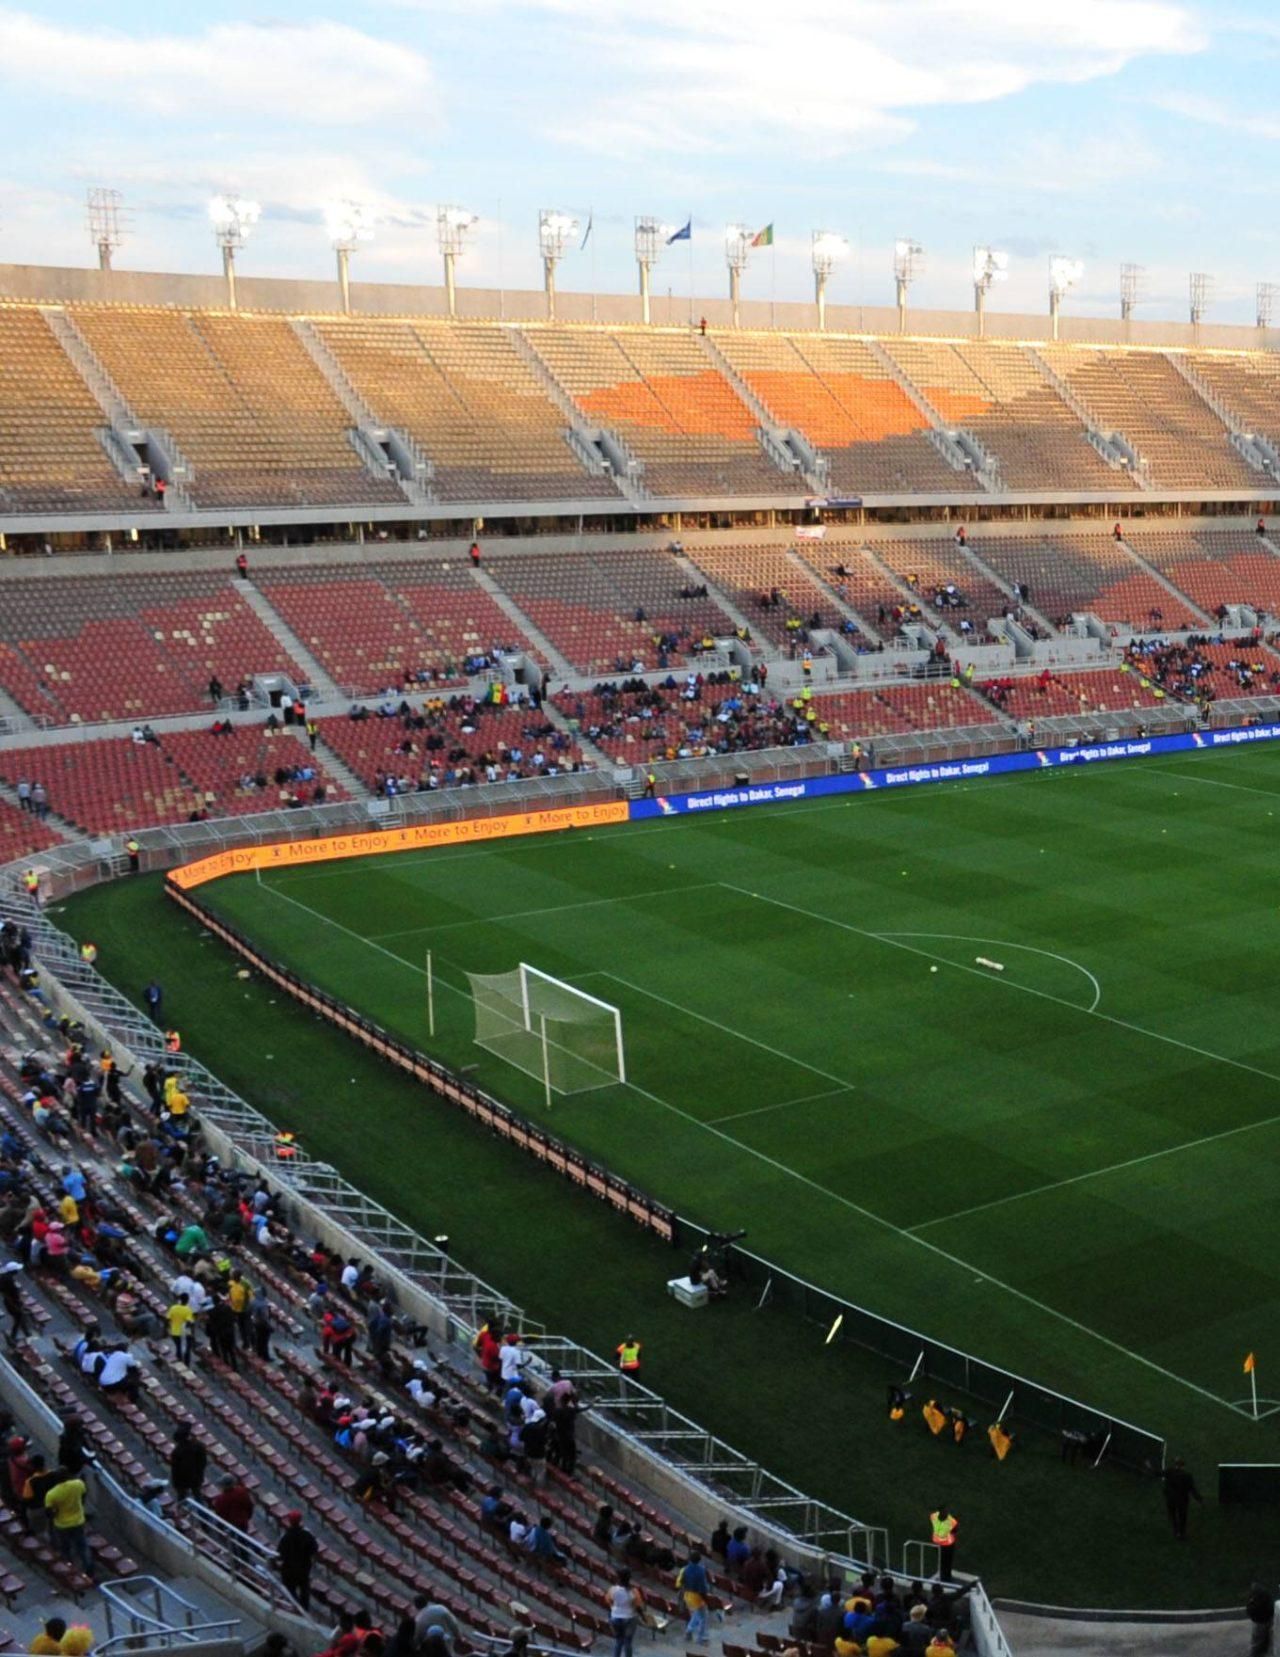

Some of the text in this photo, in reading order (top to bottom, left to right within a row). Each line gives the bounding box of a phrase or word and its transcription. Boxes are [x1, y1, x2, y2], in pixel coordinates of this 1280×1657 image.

[1214, 733, 1231, 744] Direct
[1248, 730, 1254, 740] to
[1100, 748, 1107, 757] to
[1127, 742, 1151, 754] Senegal
[886, 772, 908, 784] Direct
[908, 769, 931, 782] flights
[931, 768, 939, 778] to
[962, 761, 989, 775] Senegal
[688, 796, 713, 808] Direct
[714, 793, 738, 806] flights
[739, 792, 748, 801] to
[774, 784, 805, 798] Senegal
[539, 805, 626, 824] More to Enjoy
[415, 820, 508, 840] More to Enjoy
[288, 835, 389, 857] More to Enjoy
